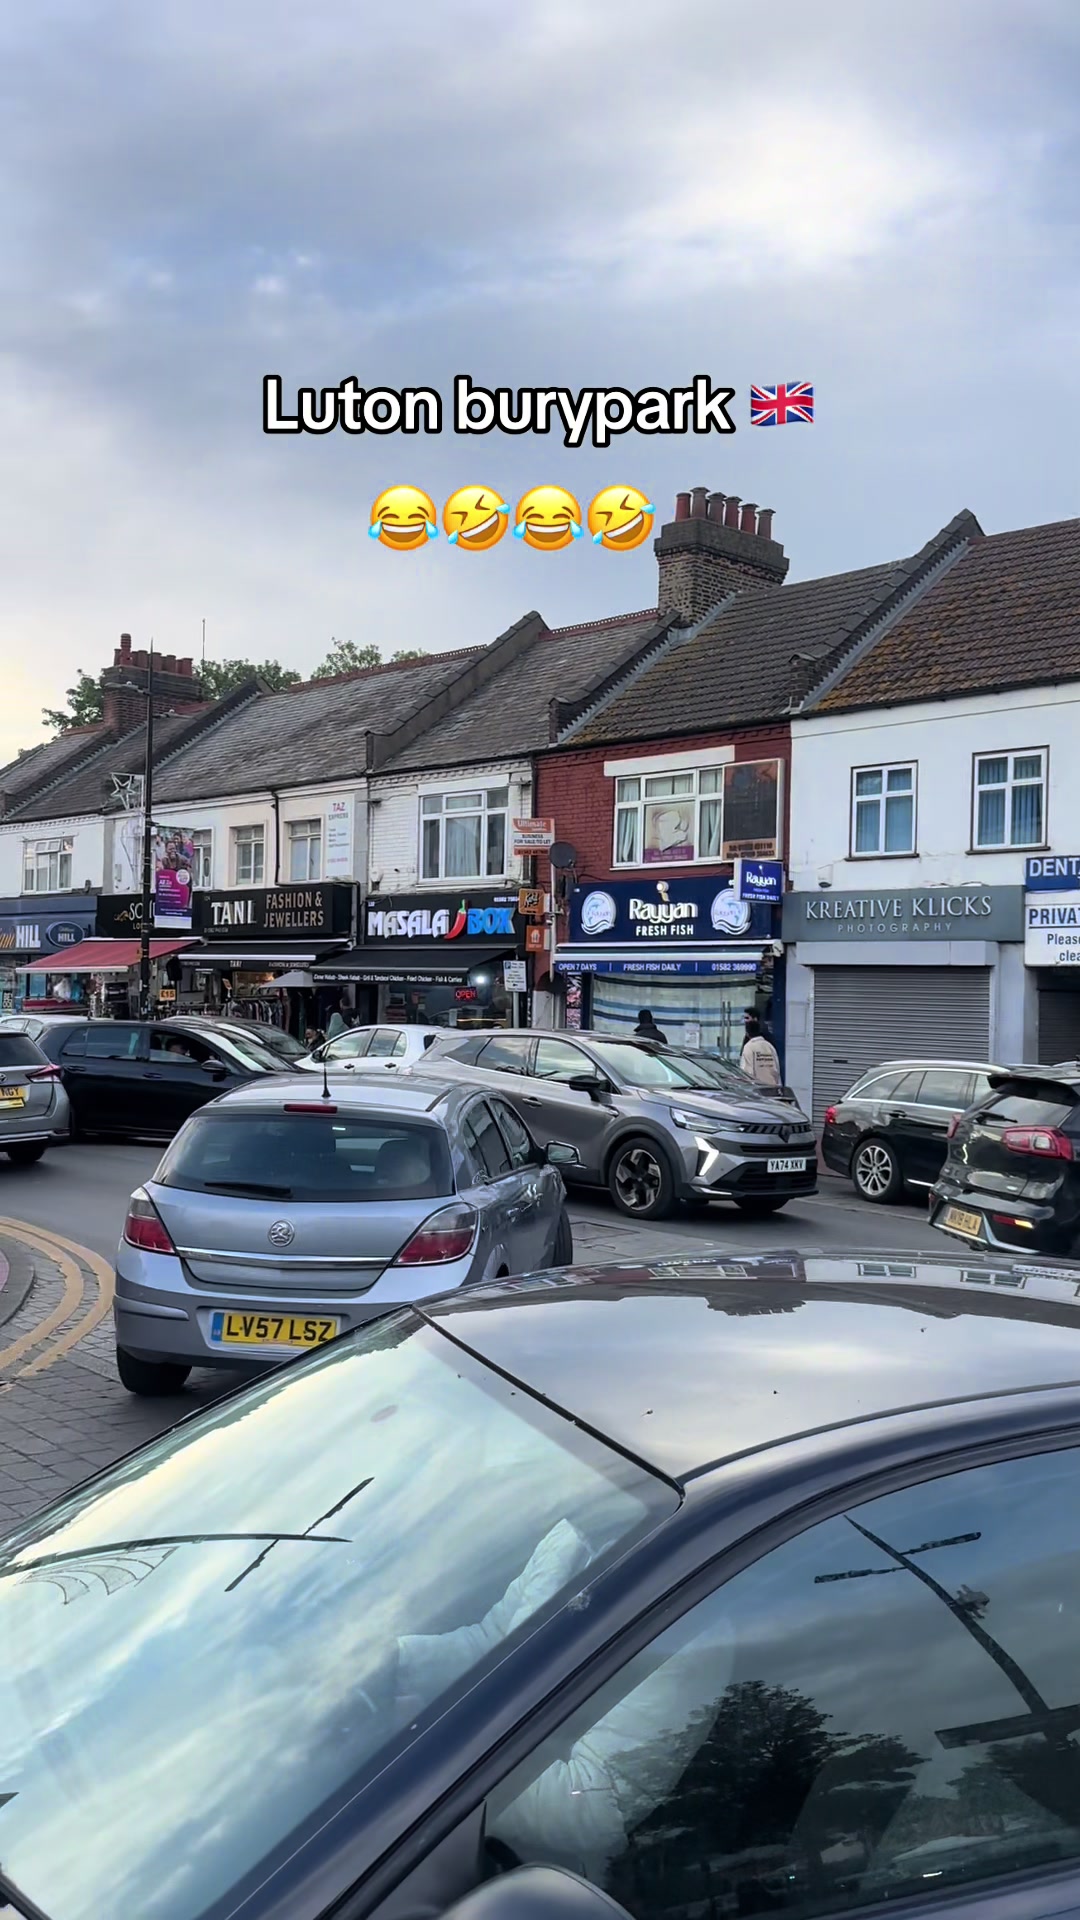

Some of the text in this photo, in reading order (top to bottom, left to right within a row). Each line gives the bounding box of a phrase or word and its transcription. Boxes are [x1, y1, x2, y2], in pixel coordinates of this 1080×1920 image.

[332, 802, 346, 812] TAZ
[1029, 858, 1080, 879] DENT
[746, 871, 777, 887] Rayyan
[266, 891, 323, 909] FASHION &
[211, 900, 255, 925] TANI
[629, 898, 698, 924] Rayyan
[805, 895, 993, 920] KREATIVE KLICKS
[263, 910, 324, 928] JEWELLERS
[367, 907, 516, 939] MASALA BOX
[635, 924, 694, 937] FRESH FISH
[838, 922, 952, 934] PHOTOGRAPHY
[15, 925, 41, 948] HILL
[57, 932, 76, 942] HILL
[1047, 933, 1080, 945] Pleas
[558, 963, 598, 971] OPEN 7 DAYS
[623, 963, 682, 971] FRESH FISH DAILY
[711, 963, 731, 971] 01582
[160, 990, 175, 998] £15
[455, 990, 476, 999] OPEN
[770, 1160, 789, 1171] YA74
[226, 1315, 333, 1342] LV57 LSZ
